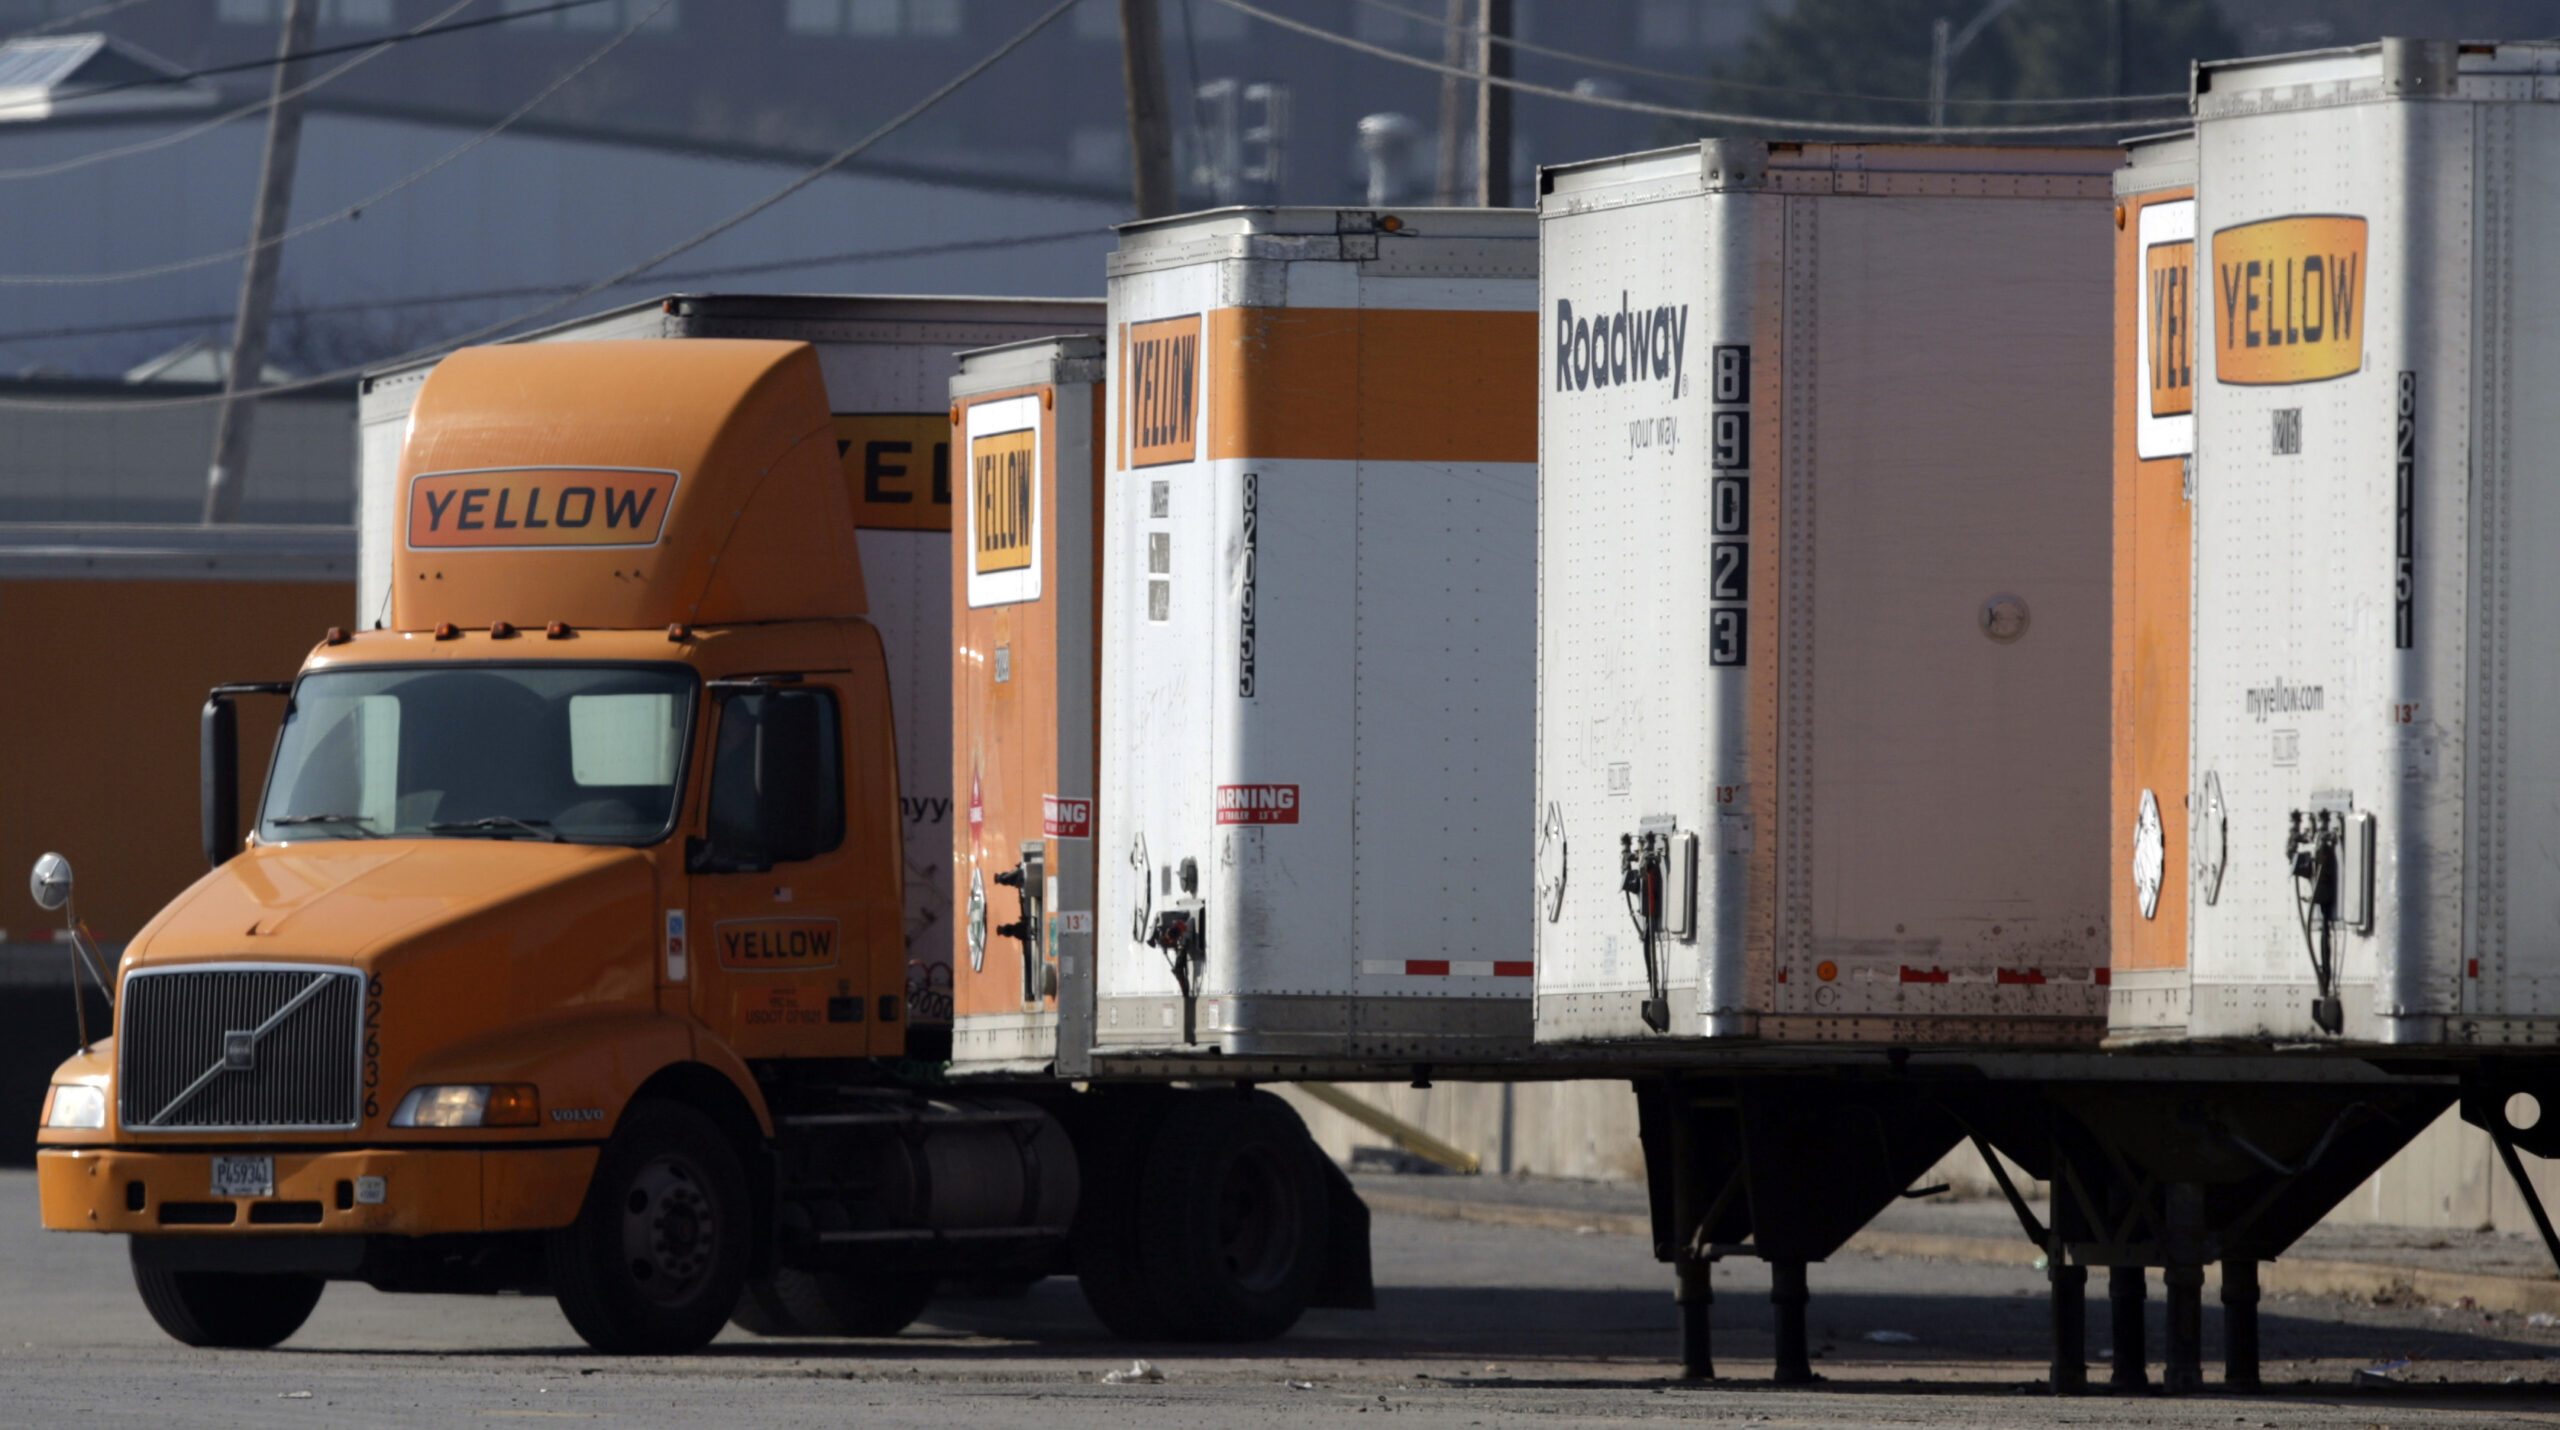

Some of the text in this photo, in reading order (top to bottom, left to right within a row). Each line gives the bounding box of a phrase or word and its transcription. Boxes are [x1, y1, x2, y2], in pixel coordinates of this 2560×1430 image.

[1556, 289, 1687, 400] Roadway
[2221, 251, 2357, 350] YELLOW
[1133, 333, 1196, 449] YELLOW
[1628, 415, 1680, 461] your way.
[425, 486, 658, 533] YELLOW
[836, 440, 952, 503] EL
[975, 449, 1032, 552] YELLOW
[1712, 347, 1742, 664] 89023
[2395, 372, 2415, 648] 821151
[1239, 474, 1256, 698] 820955
[2246, 676, 2324, 724] myyellow.com
[724, 930, 832, 959] YELLOW
[364, 971, 384, 1118] 62636
[550, 1108, 604, 1123] VOLVO
